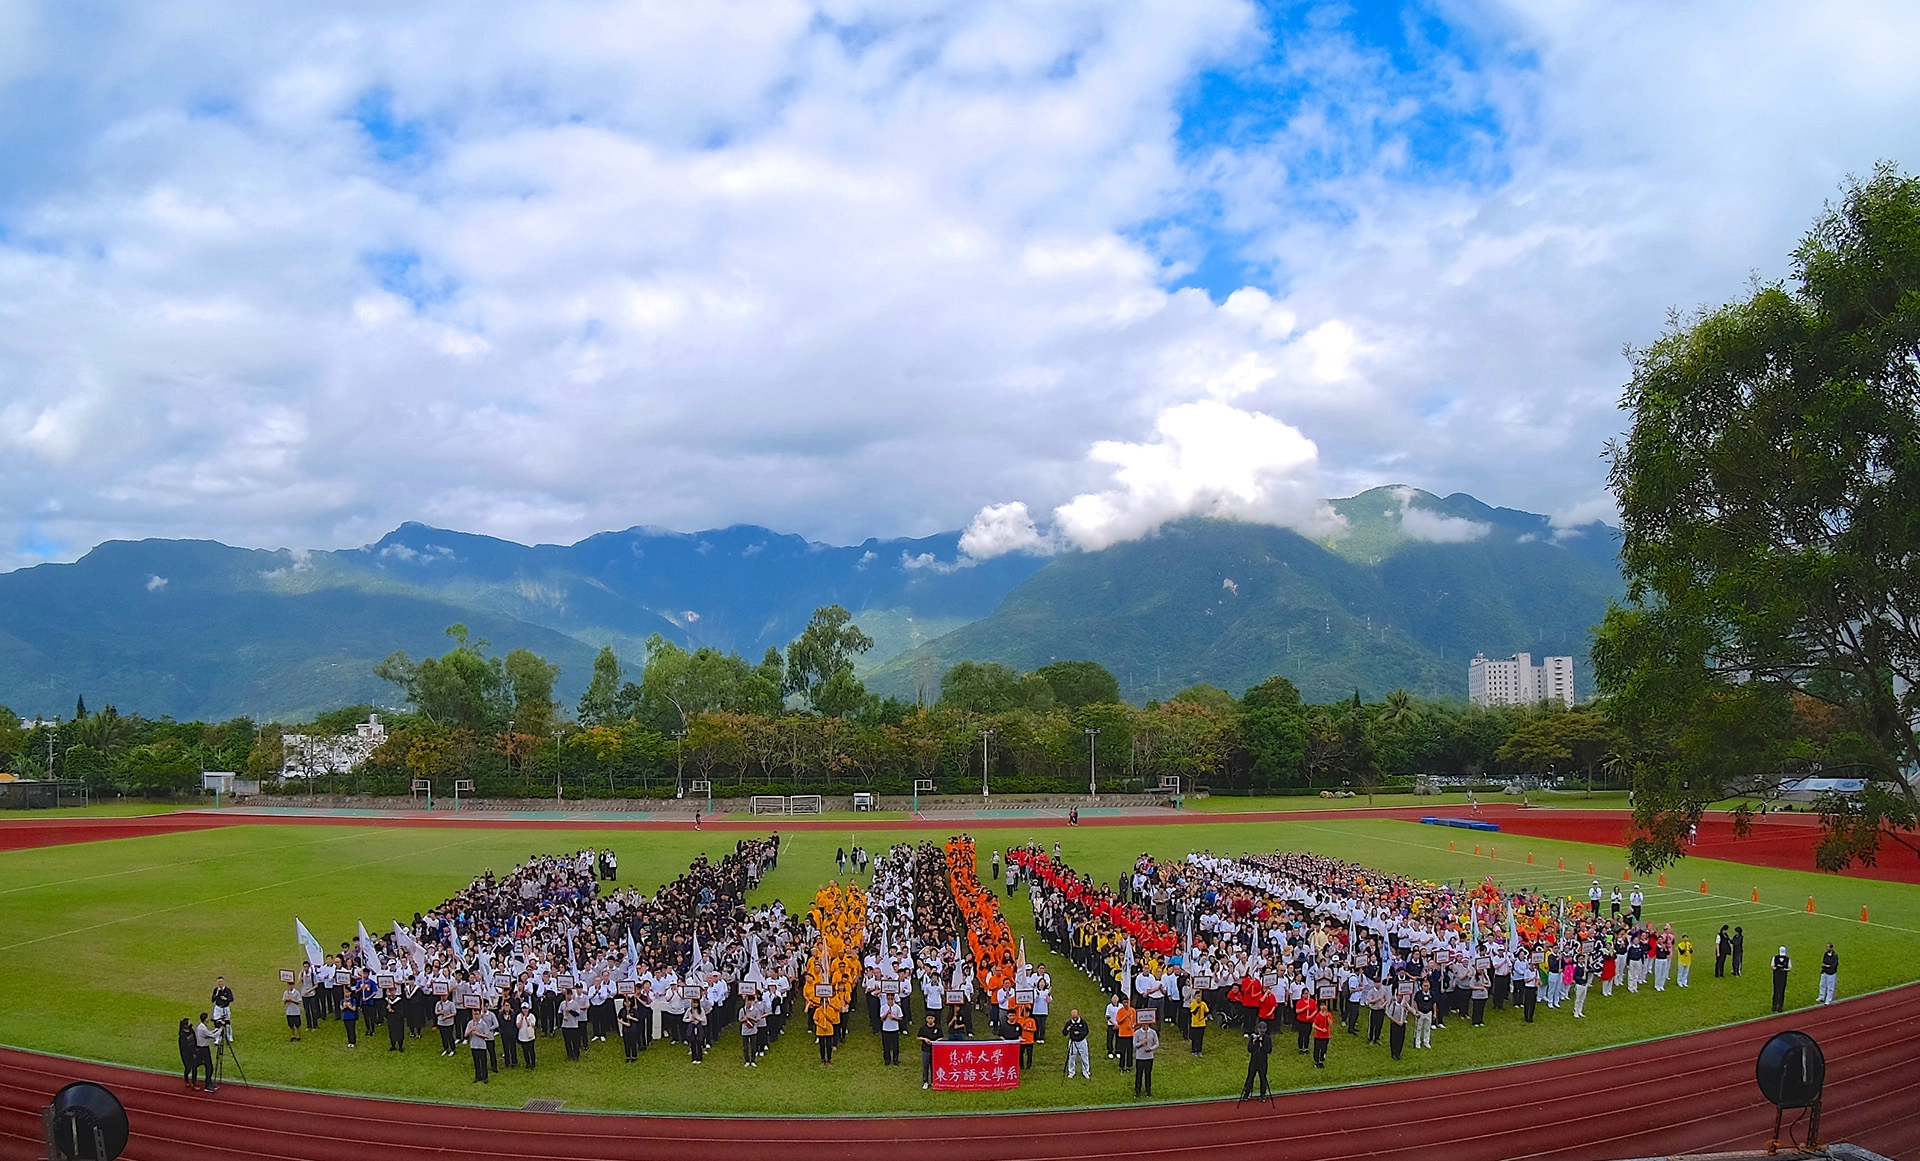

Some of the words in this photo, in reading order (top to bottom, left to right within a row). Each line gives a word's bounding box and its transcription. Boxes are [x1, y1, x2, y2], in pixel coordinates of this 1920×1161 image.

[949, 1048, 1003, 1066] 慈濟大學
[935, 1066, 1017, 1082] 東方語文學系
